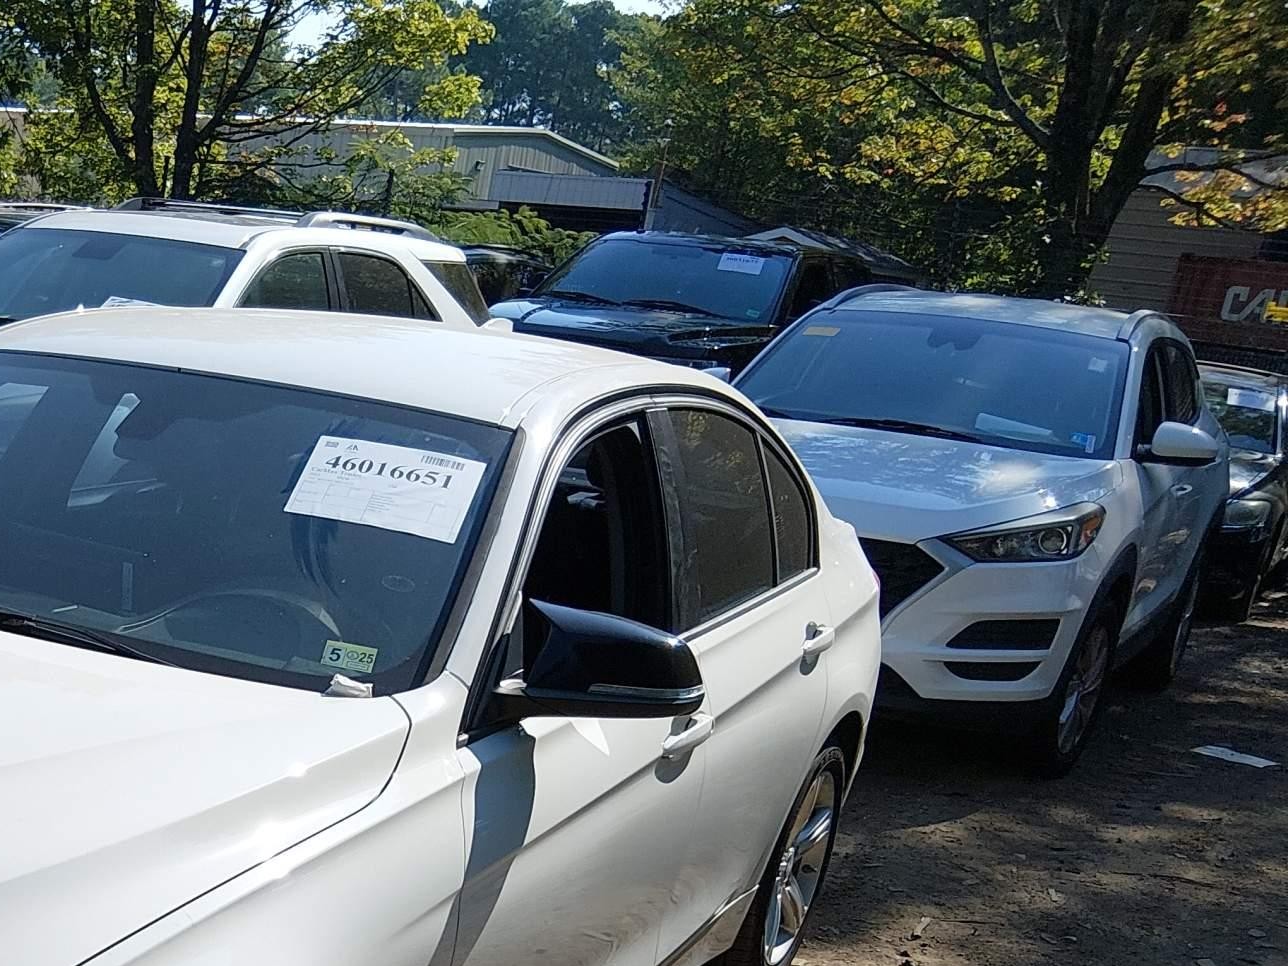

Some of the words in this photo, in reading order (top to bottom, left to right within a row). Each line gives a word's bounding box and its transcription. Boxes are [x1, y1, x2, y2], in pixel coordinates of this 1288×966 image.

[325, 455, 453, 489] 46016651
[329, 648, 342, 662] 5
[359, 652, 374, 664] 25
